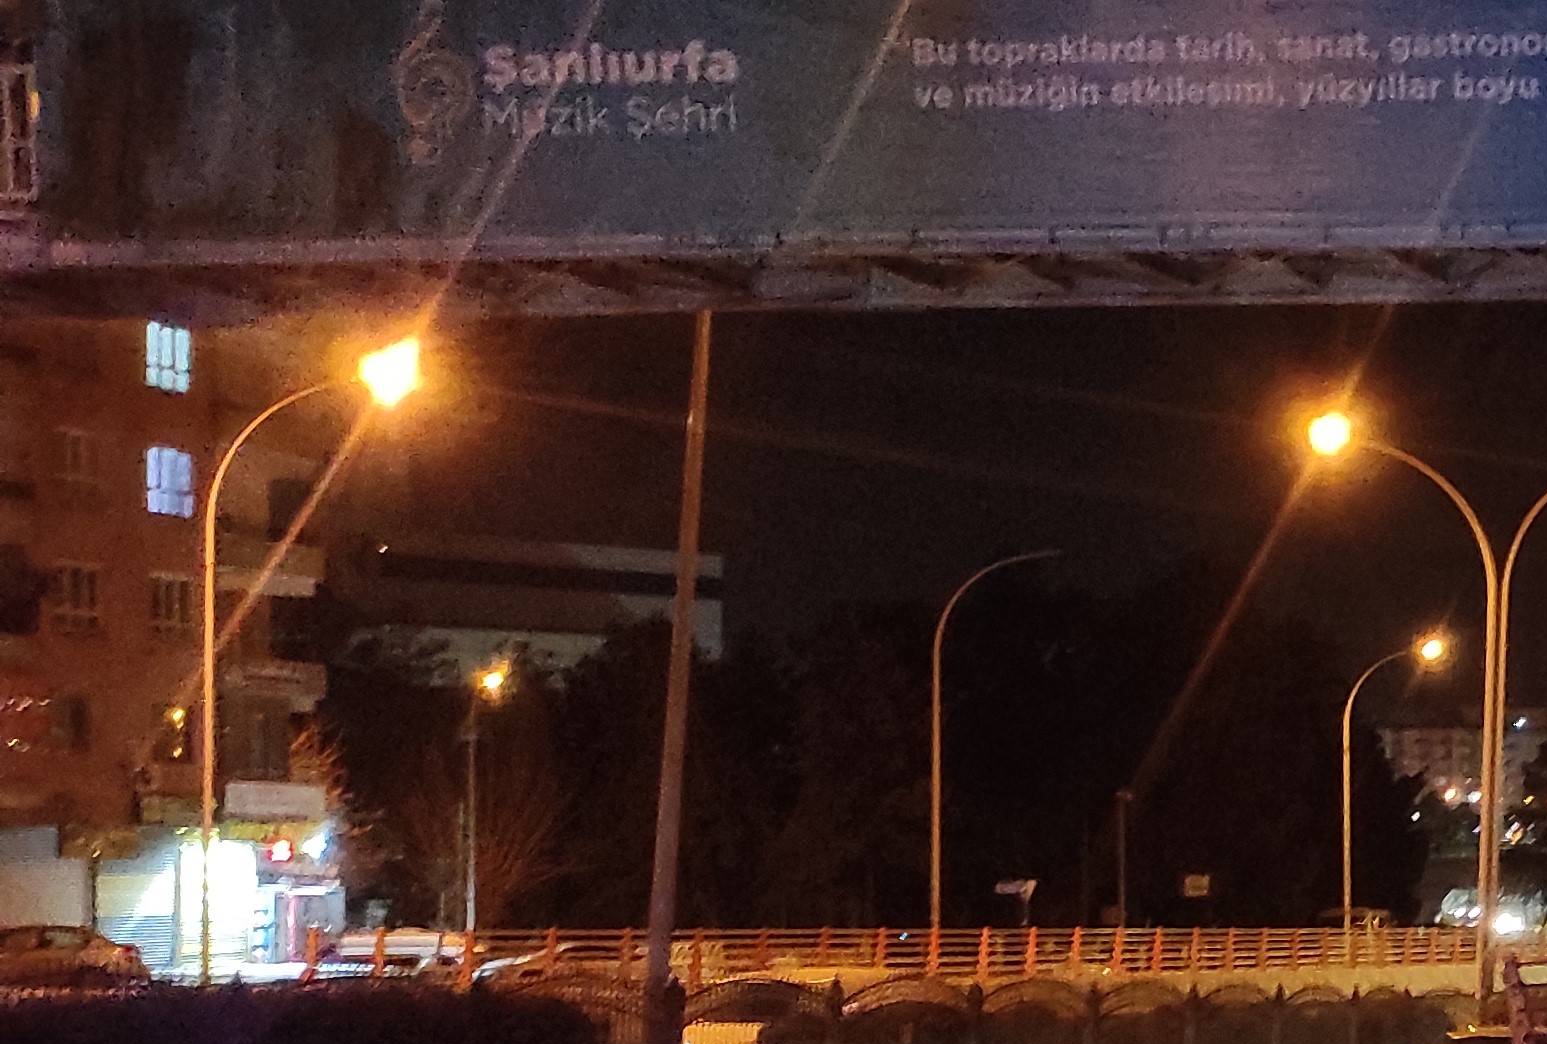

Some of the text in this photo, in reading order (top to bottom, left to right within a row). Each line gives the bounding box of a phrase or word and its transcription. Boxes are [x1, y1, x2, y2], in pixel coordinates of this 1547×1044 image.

[484, 39, 740, 93] Şanlıurfa
[968, 35, 1165, 68] topraklarda
[914, 85, 953, 108] ve
[1453, 72, 1540, 104] boyu
